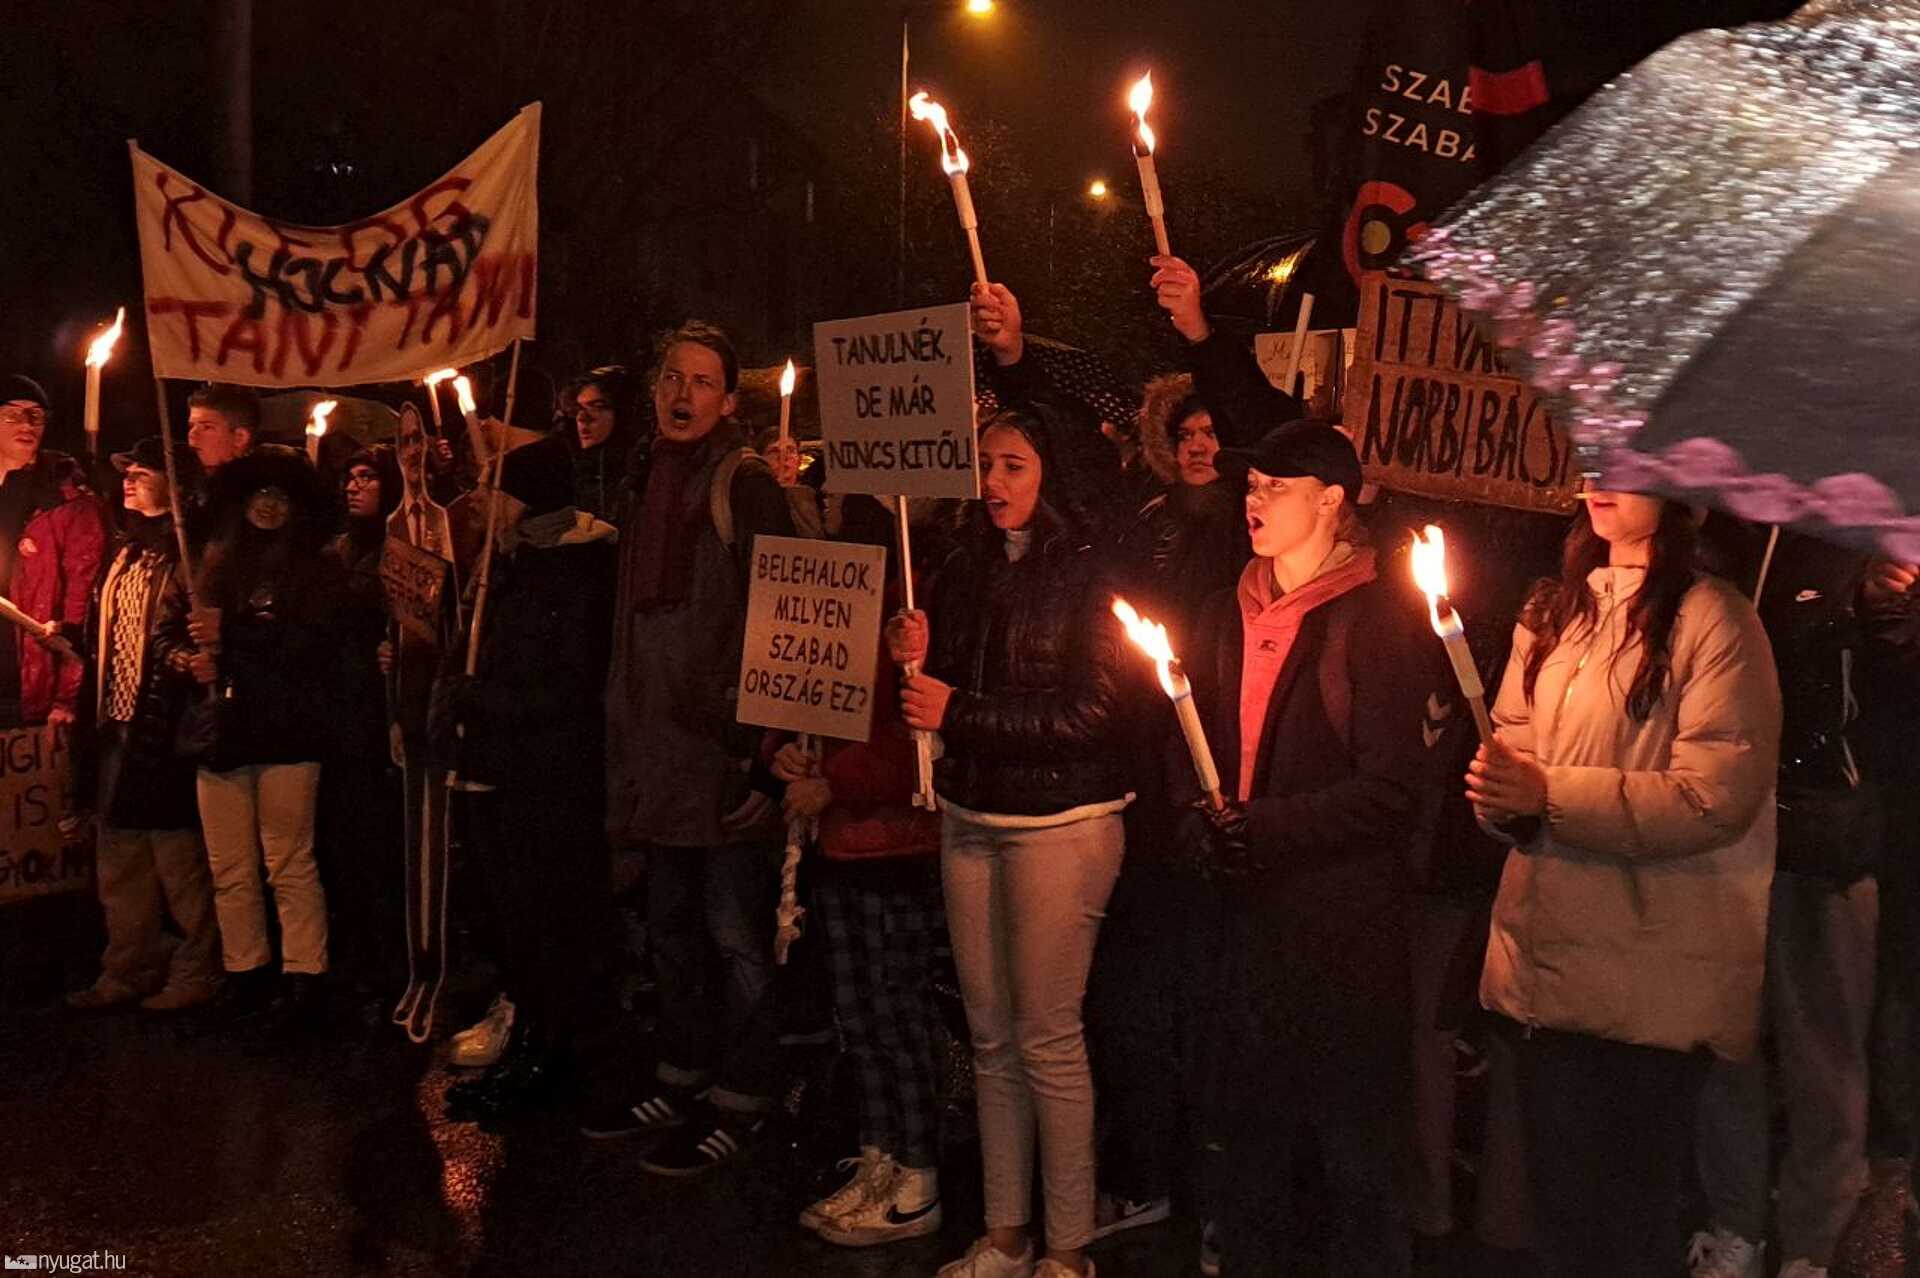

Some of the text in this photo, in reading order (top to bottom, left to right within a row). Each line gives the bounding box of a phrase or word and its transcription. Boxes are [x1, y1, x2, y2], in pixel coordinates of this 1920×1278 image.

[831, 317, 951, 365] TANULNÉK,
[856, 375, 936, 419] DE MÁR
[828, 440, 896, 470] NINCS
[758, 553, 876, 596] BELEHALOK,
[774, 594, 852, 629] MILYEN
[768, 634, 849, 671] SZABAD
[744, 667, 868, 713] ORSZÁG EZ?
[14, 785, 49, 829] IS
